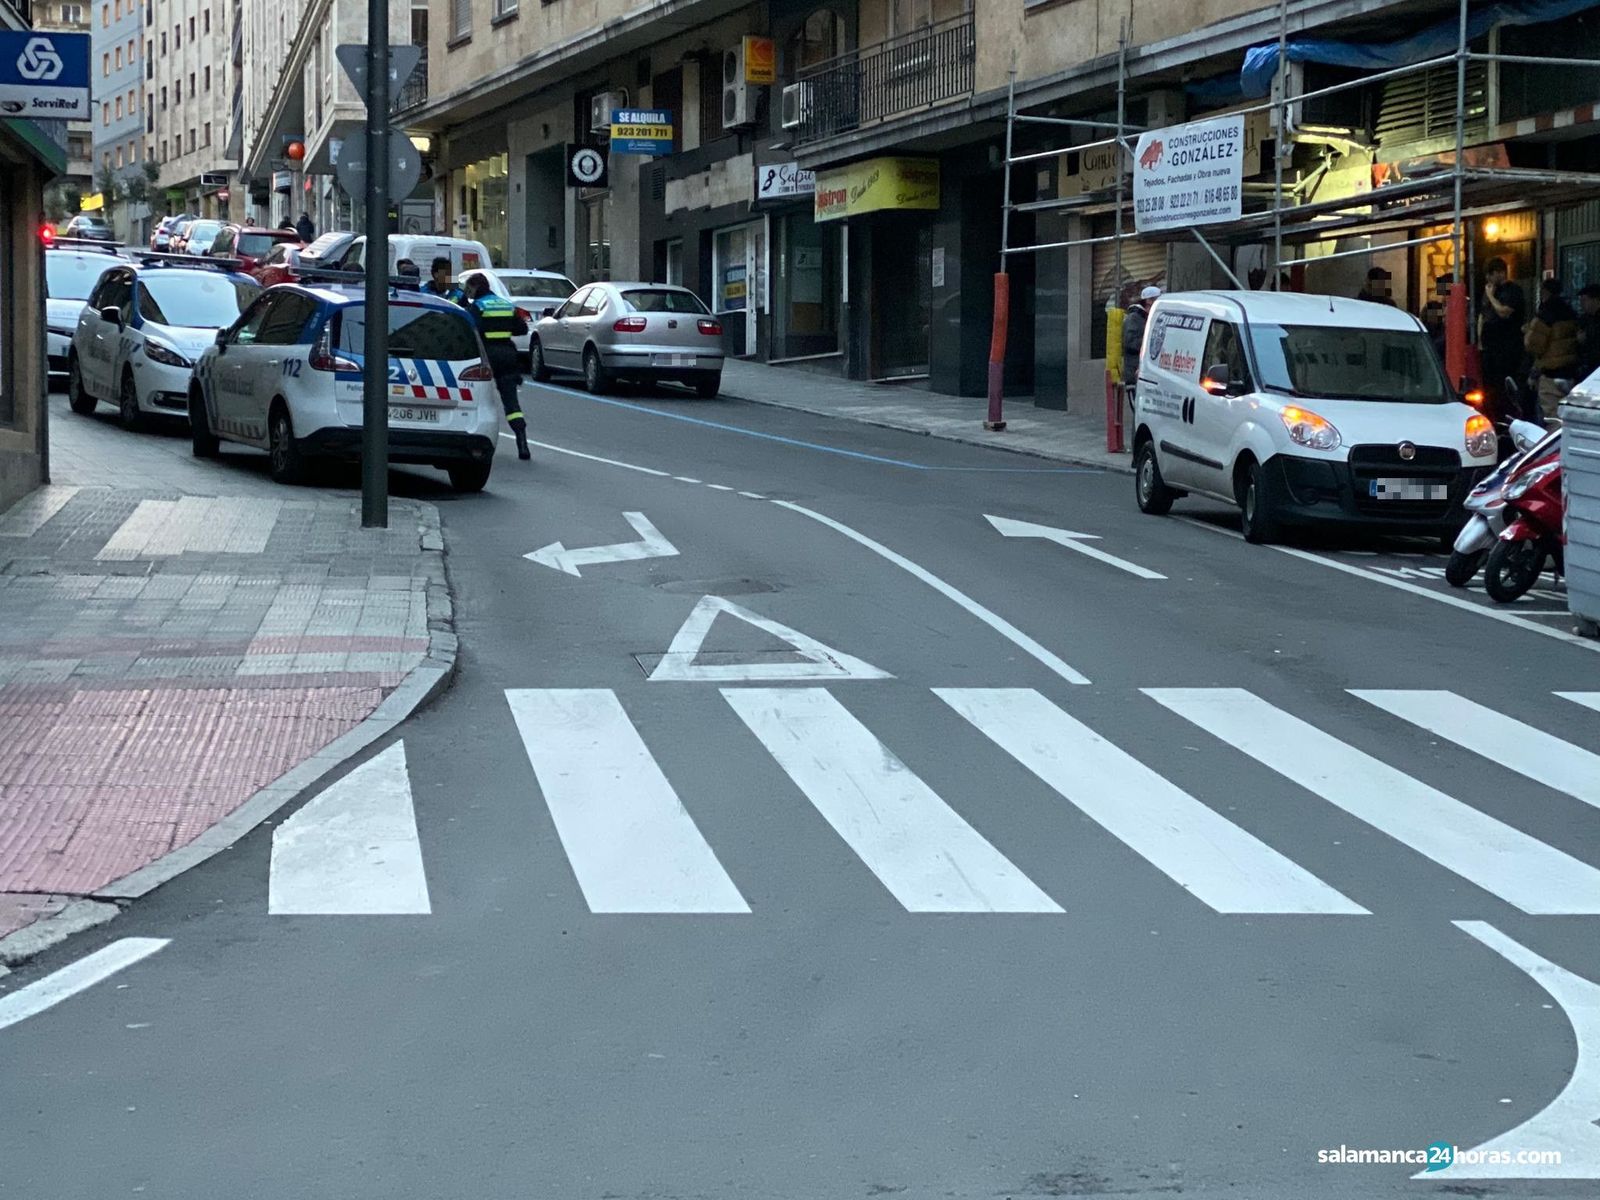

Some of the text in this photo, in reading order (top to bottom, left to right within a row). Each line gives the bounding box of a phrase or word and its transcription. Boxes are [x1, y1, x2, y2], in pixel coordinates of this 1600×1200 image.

[32, 97, 79, 110] ServiRed
[618, 112, 666, 124] SE ALQUILA
[617, 127, 668, 137] 923 201 711
[1168, 126, 1239, 149] CONSTRUCCIONES
[1167, 172, 1193, 185] Fachadas
[1197, 169, 1212, 180] Obra
[1212, 167, 1231, 177] nueva
[283, 357, 302, 378] 112
[417, 410, 437, 421] JVH
